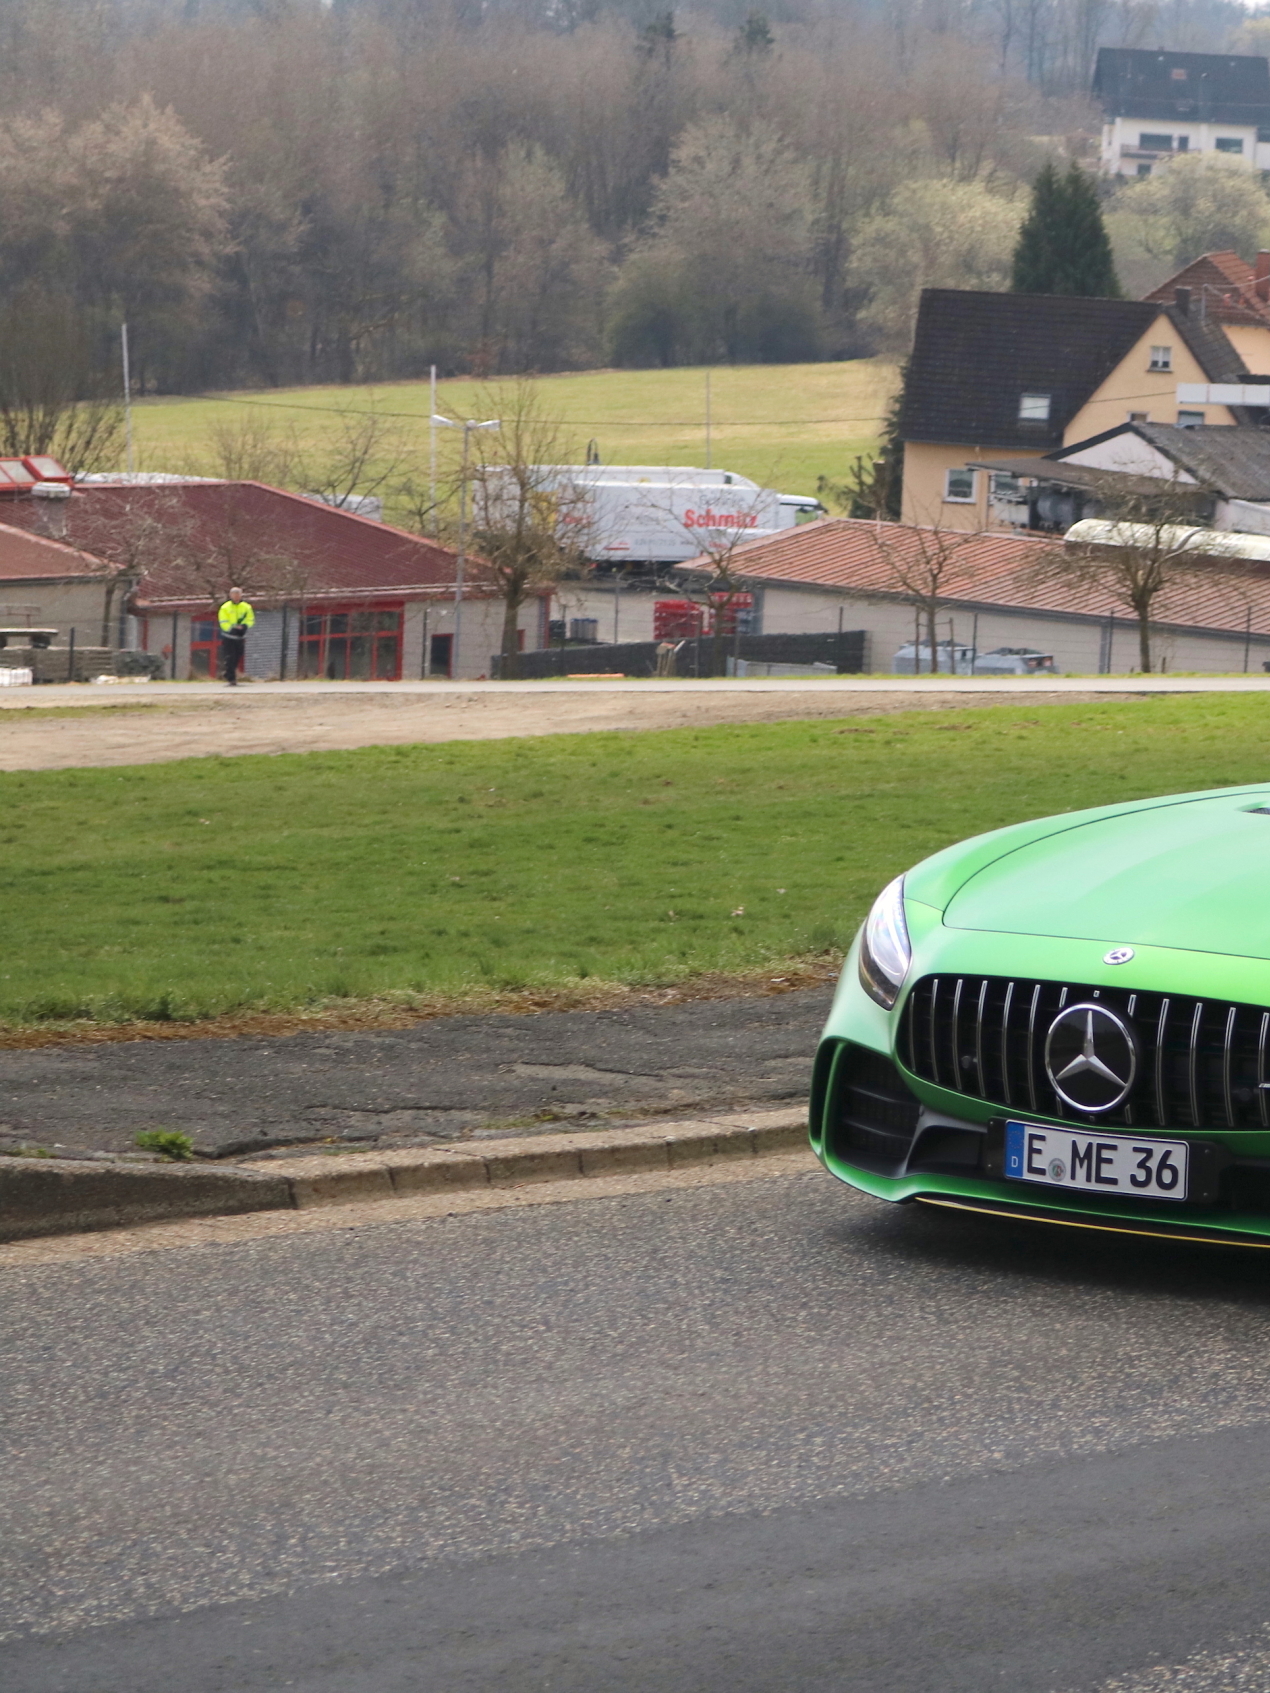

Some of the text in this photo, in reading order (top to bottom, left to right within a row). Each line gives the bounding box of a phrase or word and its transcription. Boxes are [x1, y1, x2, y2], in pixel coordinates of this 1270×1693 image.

[683, 508, 759, 528] Schmitz
[1027, 1133, 1179, 1191] E ME 36
